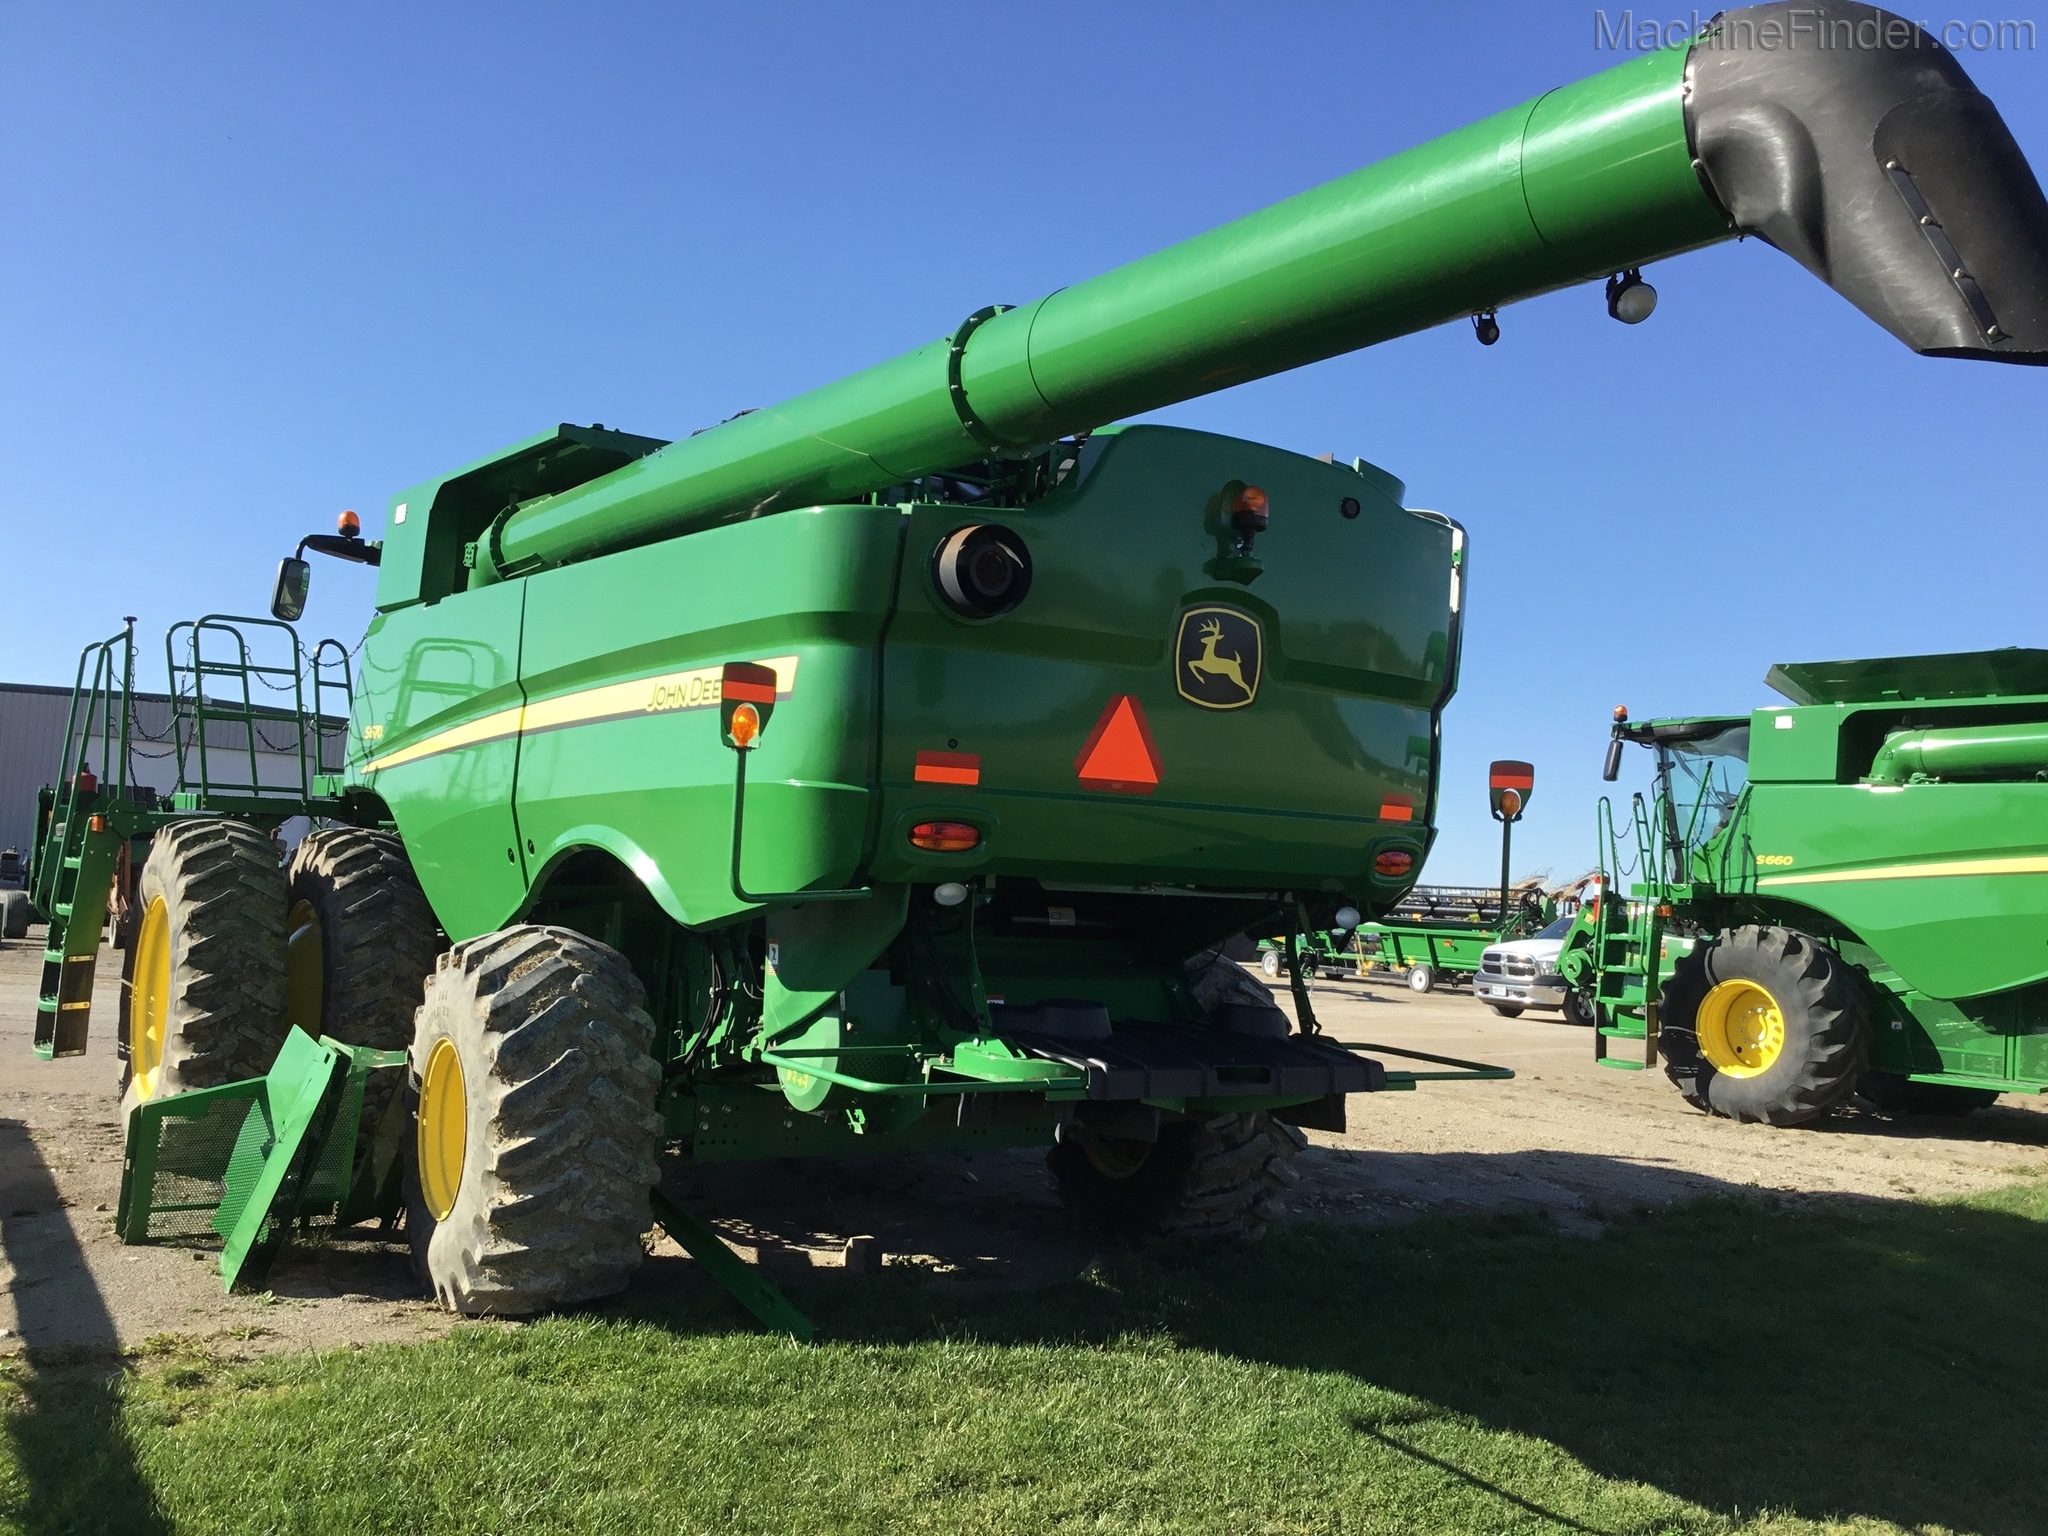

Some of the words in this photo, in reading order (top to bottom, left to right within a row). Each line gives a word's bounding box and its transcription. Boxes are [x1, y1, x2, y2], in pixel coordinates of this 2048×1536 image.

[647, 683, 688, 707] JOHN
[690, 677, 722, 702] DEE
[1755, 854, 1794, 866] S660
